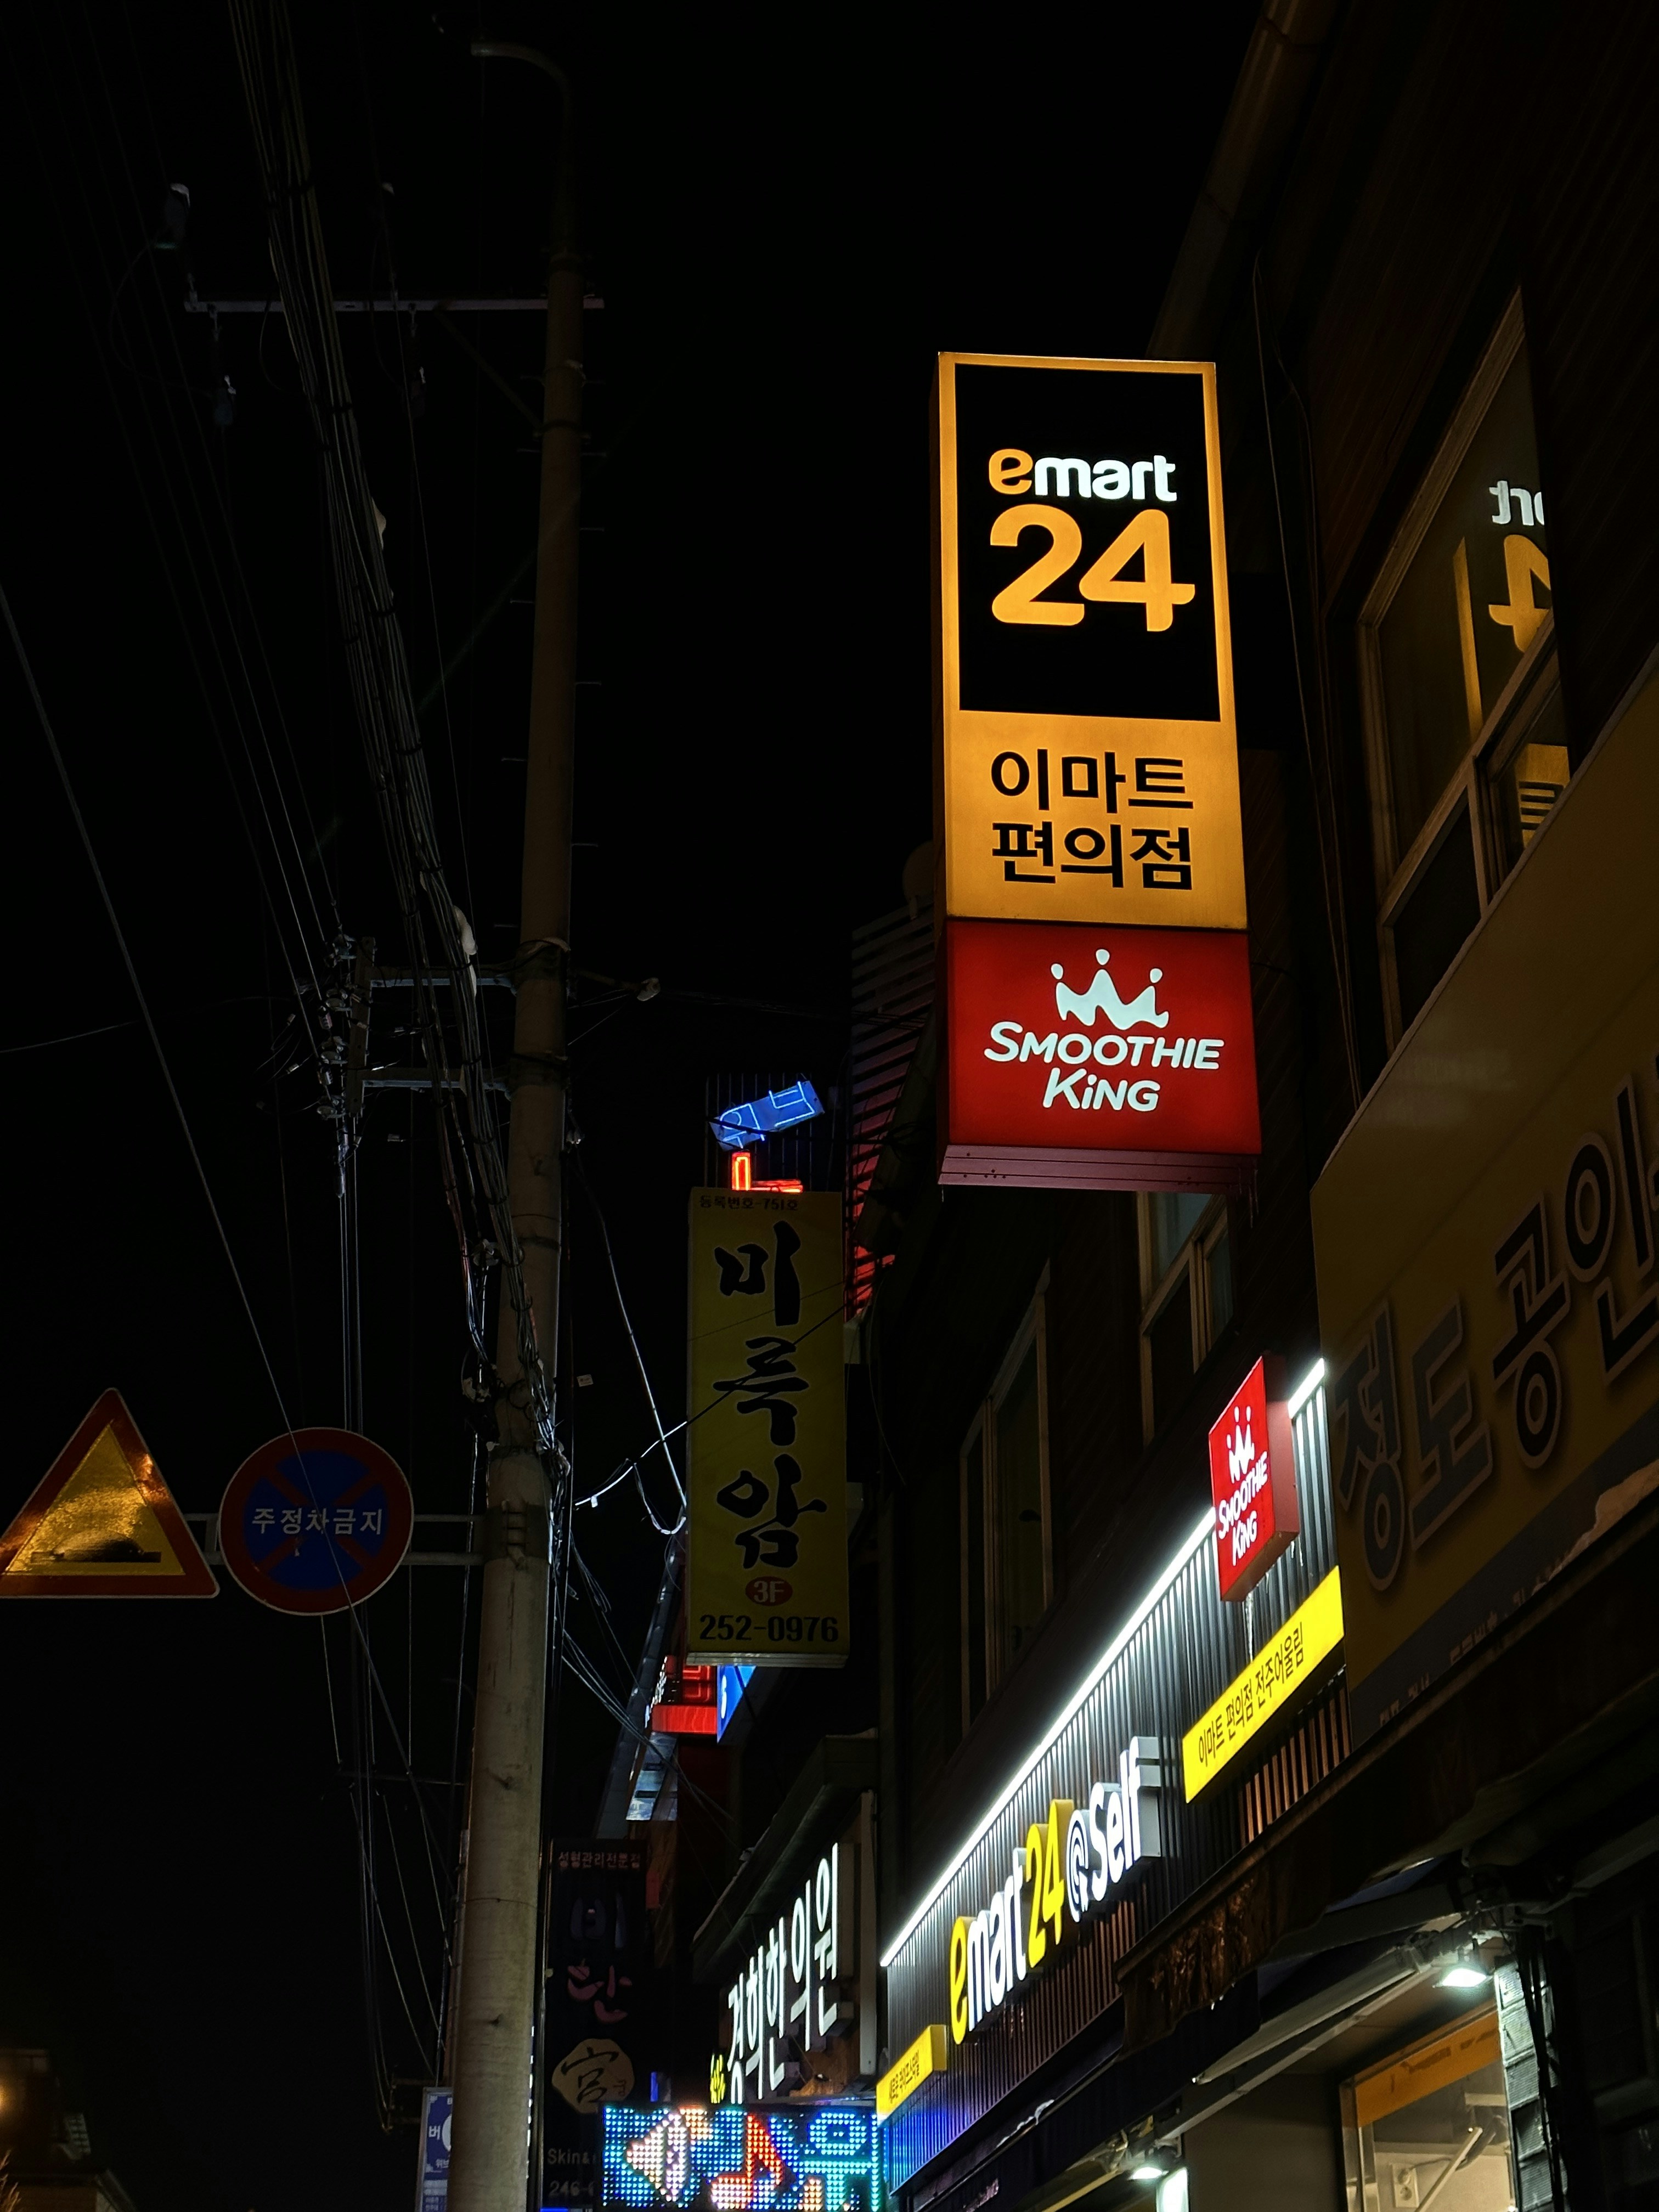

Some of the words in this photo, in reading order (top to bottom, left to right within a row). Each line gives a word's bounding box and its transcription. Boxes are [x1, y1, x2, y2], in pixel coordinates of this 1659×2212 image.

[988, 448, 1177, 501] emart
[990, 504, 1195, 632] 24
[991, 748, 1194, 814] 이마트
[992, 821, 1193, 890] 편의점
[252, 1508, 383, 1536] 주정차금지
[753, 1580, 785, 1604] 3F
[699, 1615, 839, 1643] 252-0976
[1199, 1714, 1224, 1767] 이마트
[1226, 1678, 1254, 1741] 편의점
[1255, 1621, 1304, 1709] 전주어울림
